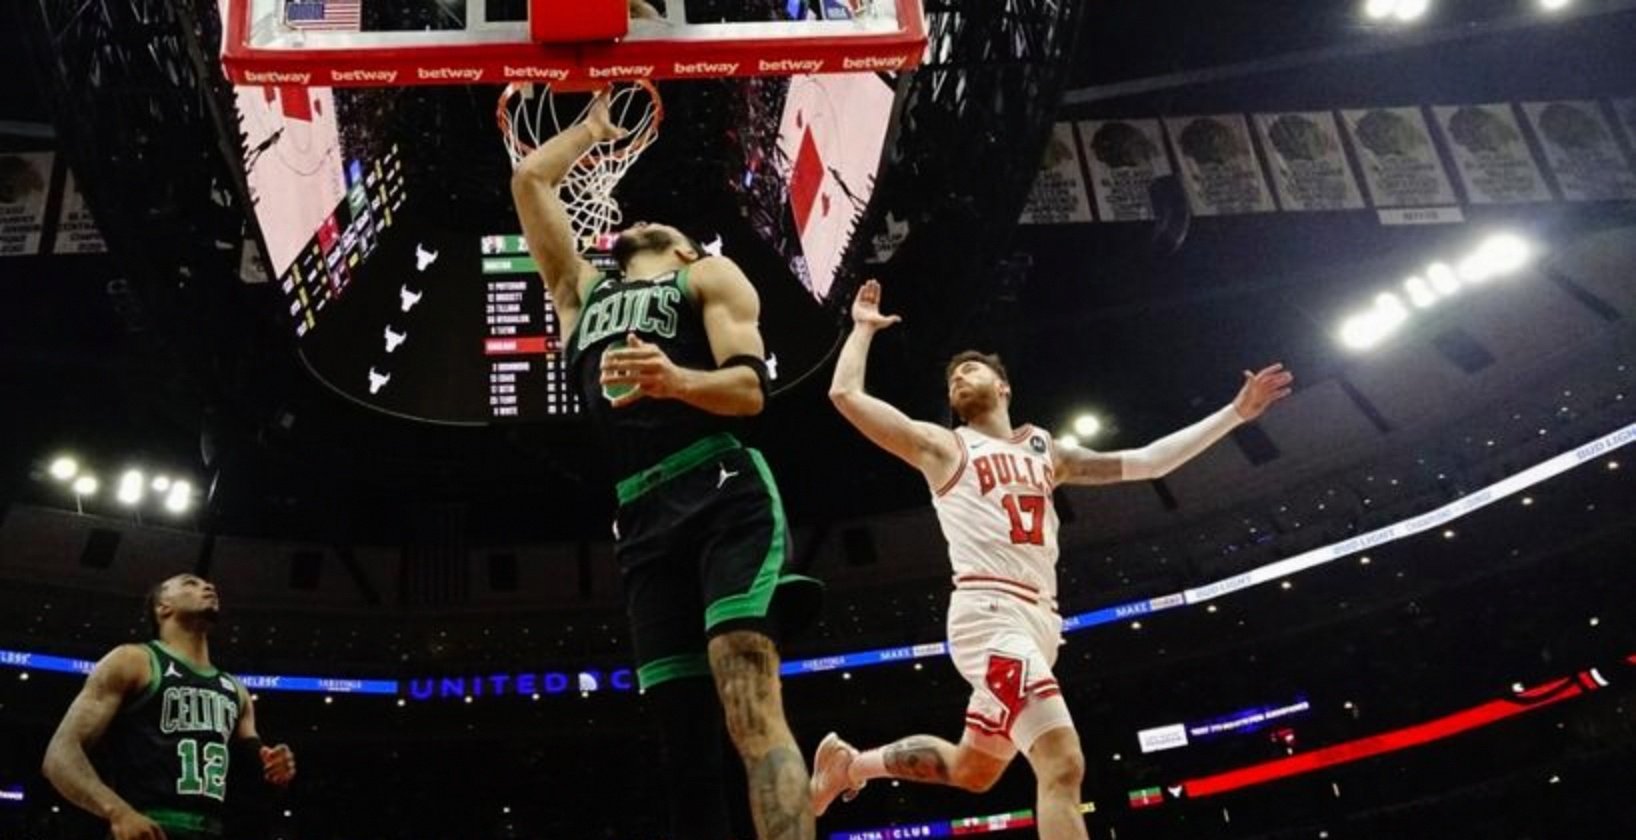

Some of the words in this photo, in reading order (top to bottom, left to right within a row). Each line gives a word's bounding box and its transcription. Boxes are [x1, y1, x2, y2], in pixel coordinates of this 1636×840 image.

[674, 61, 740, 75] betway
[758, 58, 824, 72] betway
[842, 55, 908, 70] betway
[245, 71, 311, 84] betway
[331, 69, 398, 82] betway
[417, 67, 484, 79] betway
[503, 65, 570, 80] betway
[589, 64, 654, 78] betway
[577, 285, 681, 351] CELTICS
[1001, 493, 1045, 546] 17
[410, 672, 569, 700] UNITED
[176, 738, 230, 802] 12
[893, 825, 931, 839] CLUB
